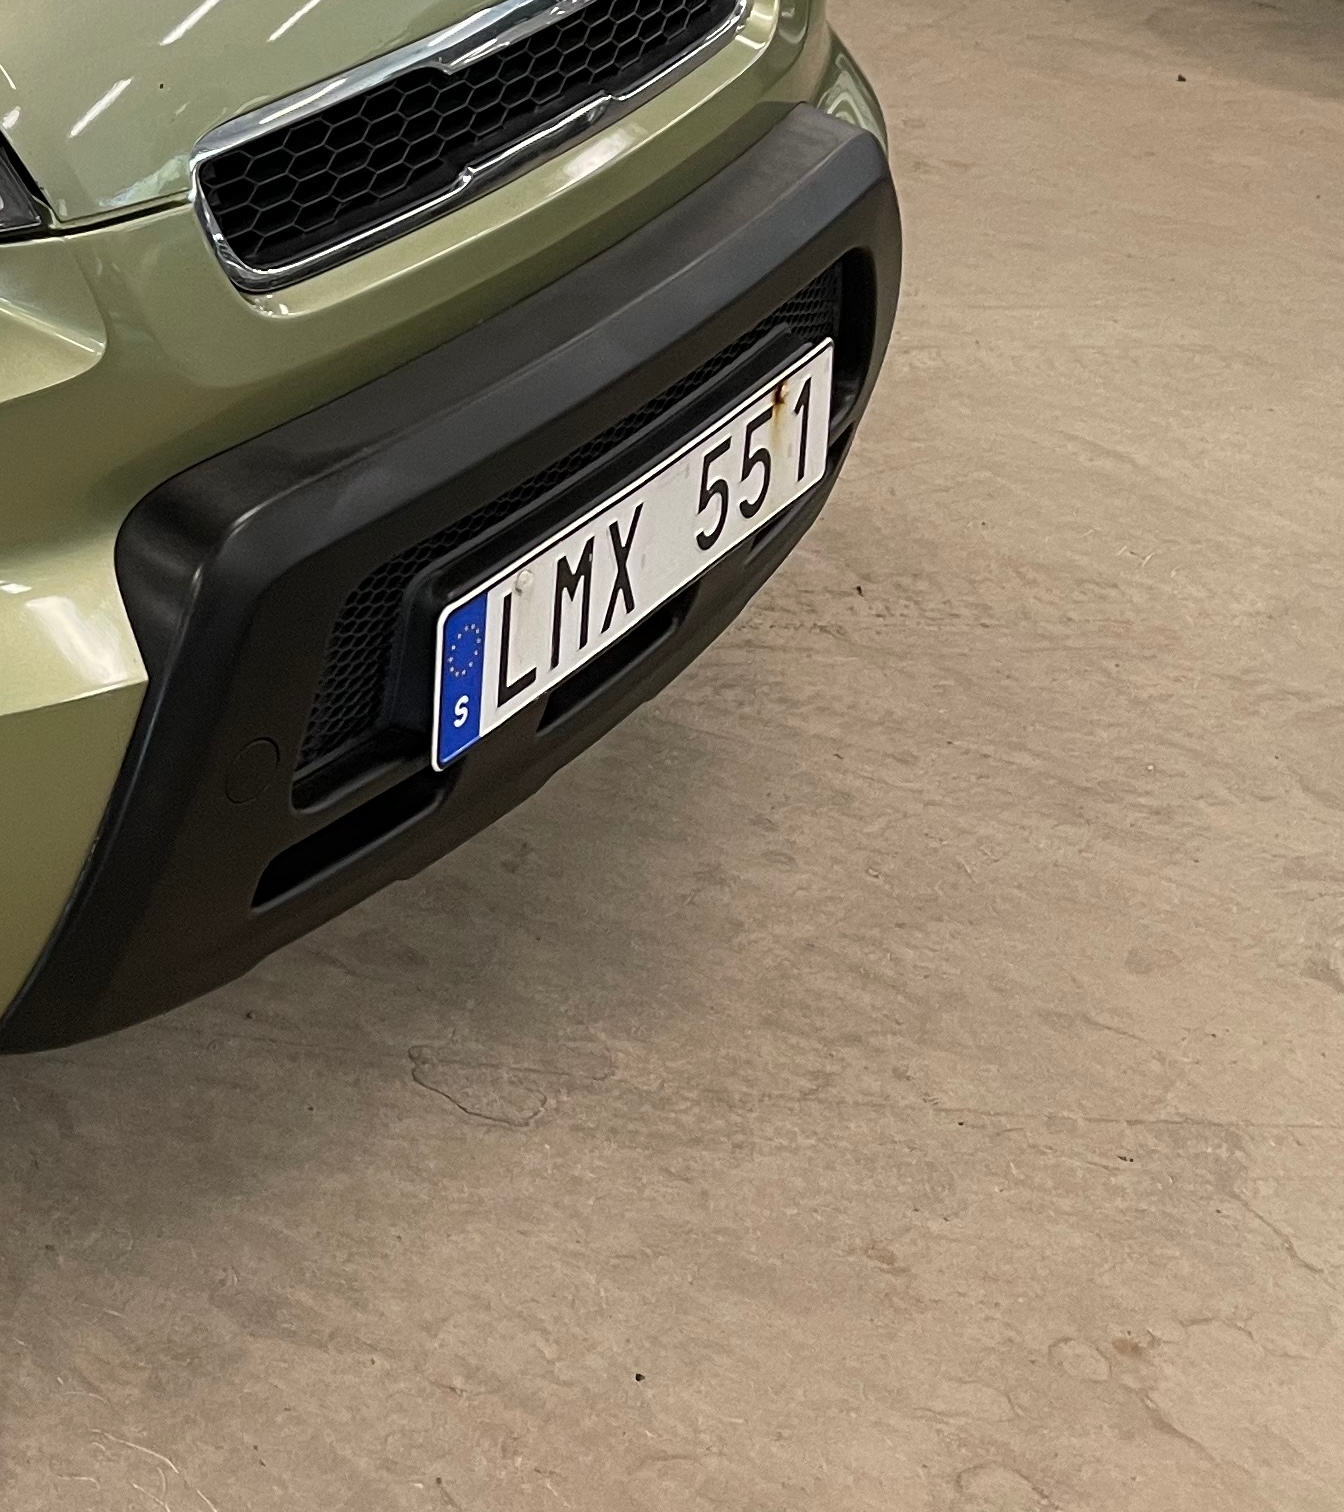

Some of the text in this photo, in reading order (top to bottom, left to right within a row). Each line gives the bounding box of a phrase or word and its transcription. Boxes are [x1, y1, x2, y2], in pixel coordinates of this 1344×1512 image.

[453, 376, 813, 729] S LMX 551
